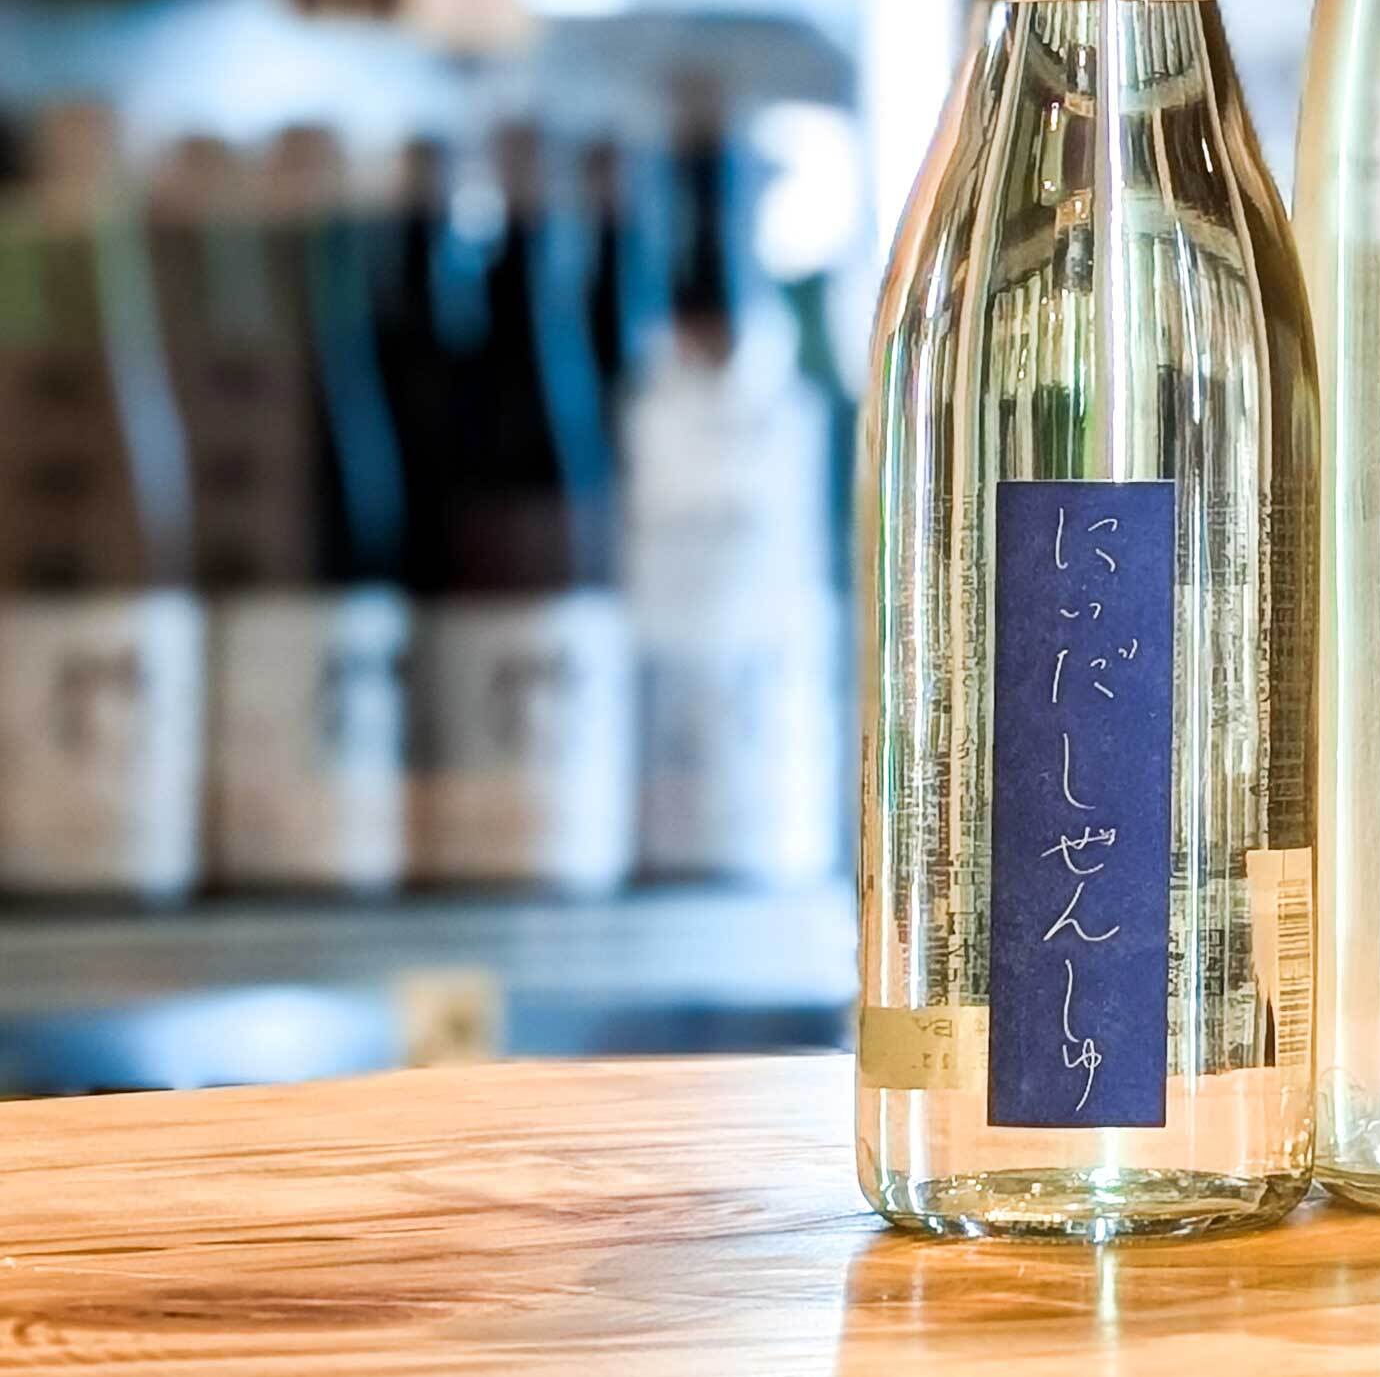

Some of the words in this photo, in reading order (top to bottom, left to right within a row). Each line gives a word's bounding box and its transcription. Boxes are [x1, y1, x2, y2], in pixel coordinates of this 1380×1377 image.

[1040, 507, 1139, 1112] にいだしぜんしゅ
